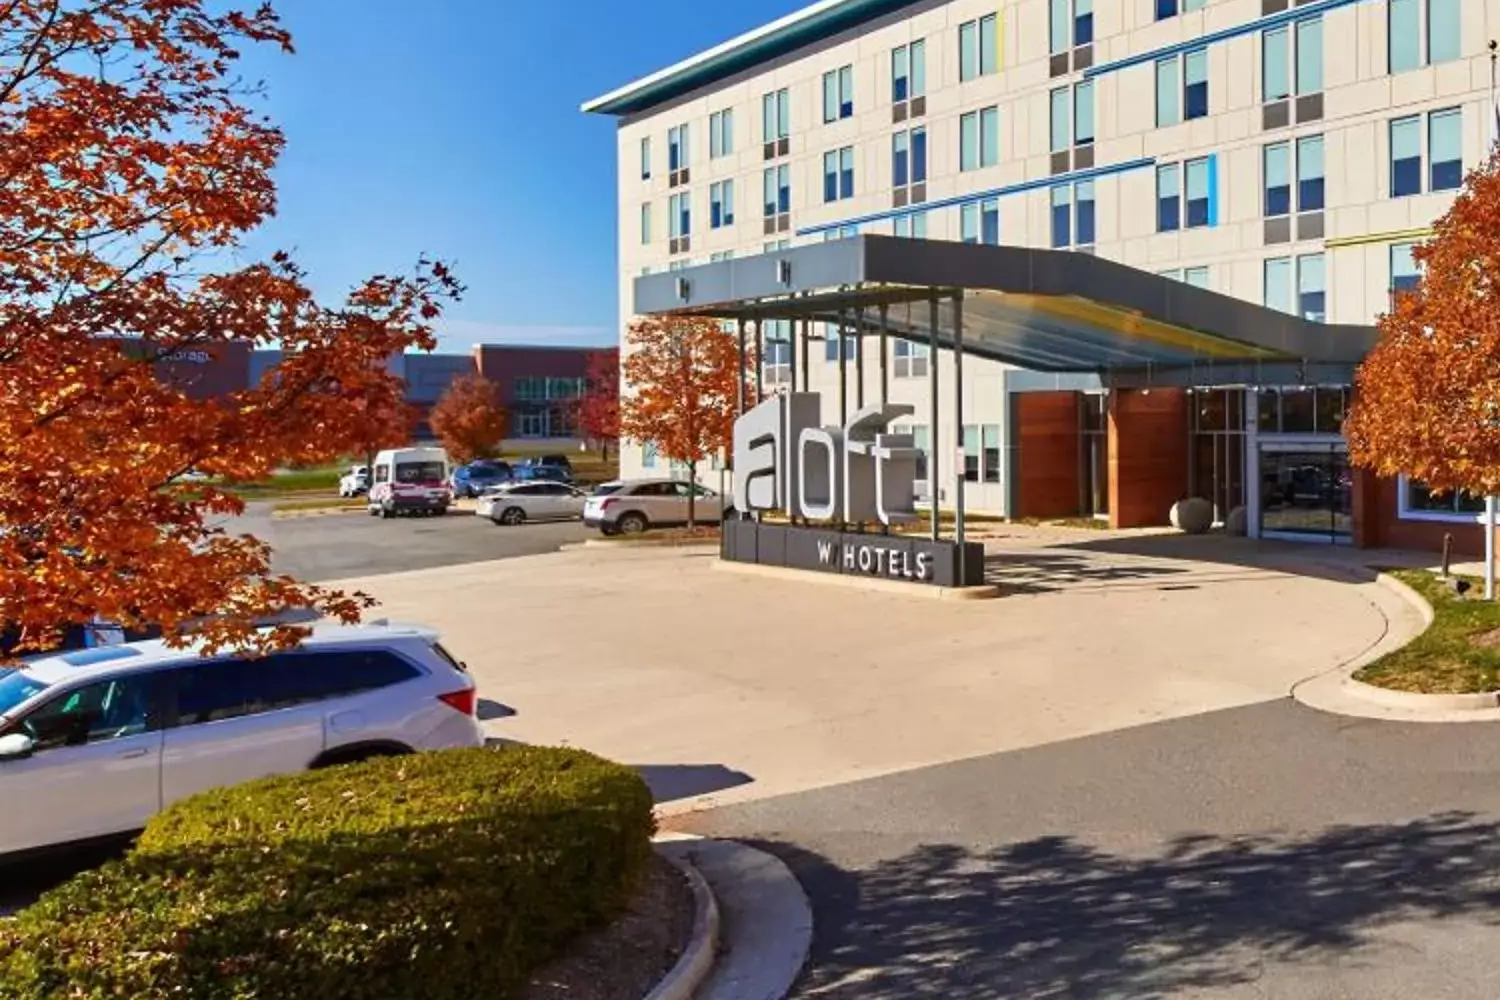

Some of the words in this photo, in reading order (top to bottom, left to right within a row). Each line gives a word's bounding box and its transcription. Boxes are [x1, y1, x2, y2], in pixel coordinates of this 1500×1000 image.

[733, 391, 898, 525] aloft
[817, 539, 831, 565] W
[843, 544, 926, 578] HOTELS
